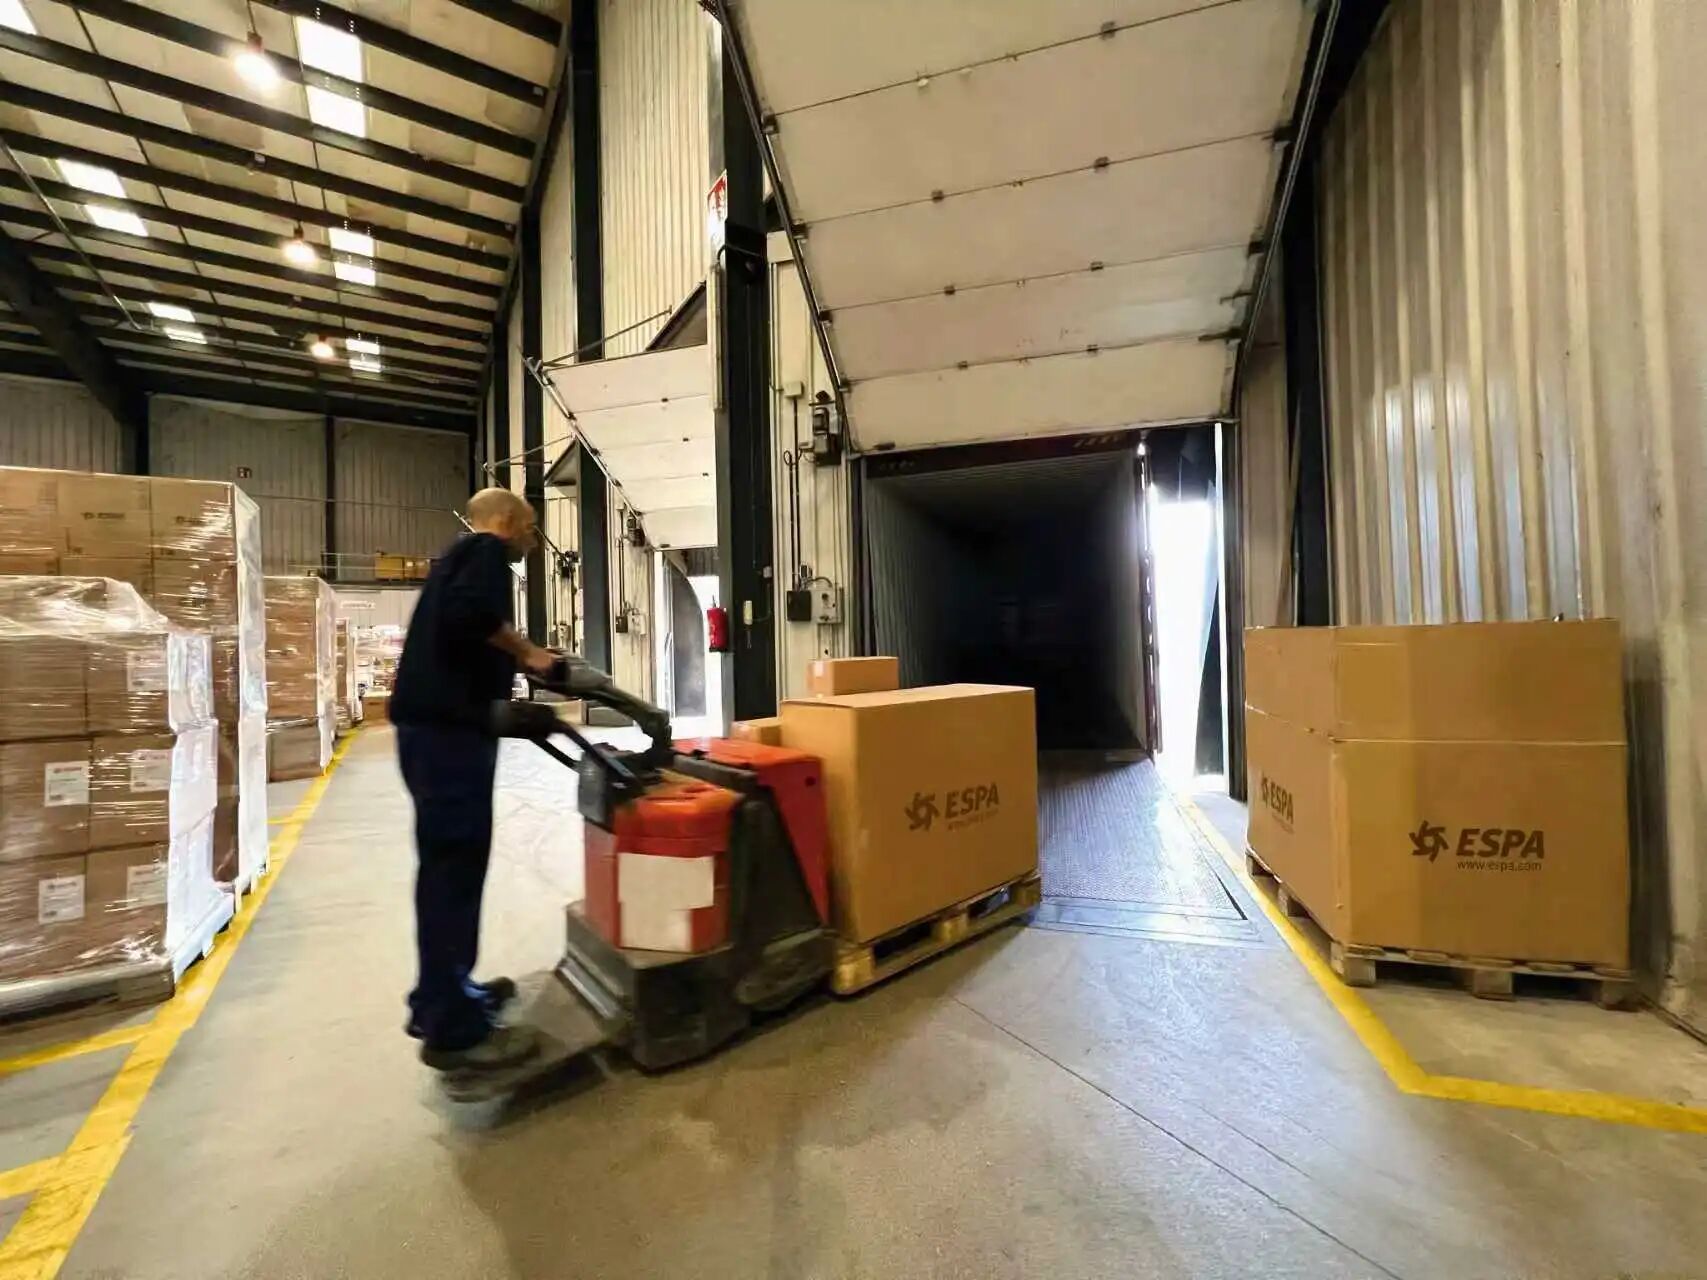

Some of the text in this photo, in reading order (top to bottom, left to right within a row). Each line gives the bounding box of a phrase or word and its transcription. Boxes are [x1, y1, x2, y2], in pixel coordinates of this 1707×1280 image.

[945, 782, 999, 819] ESPA
[1270, 781, 1294, 825] ESPA
[1455, 828, 1545, 859] ESPA
